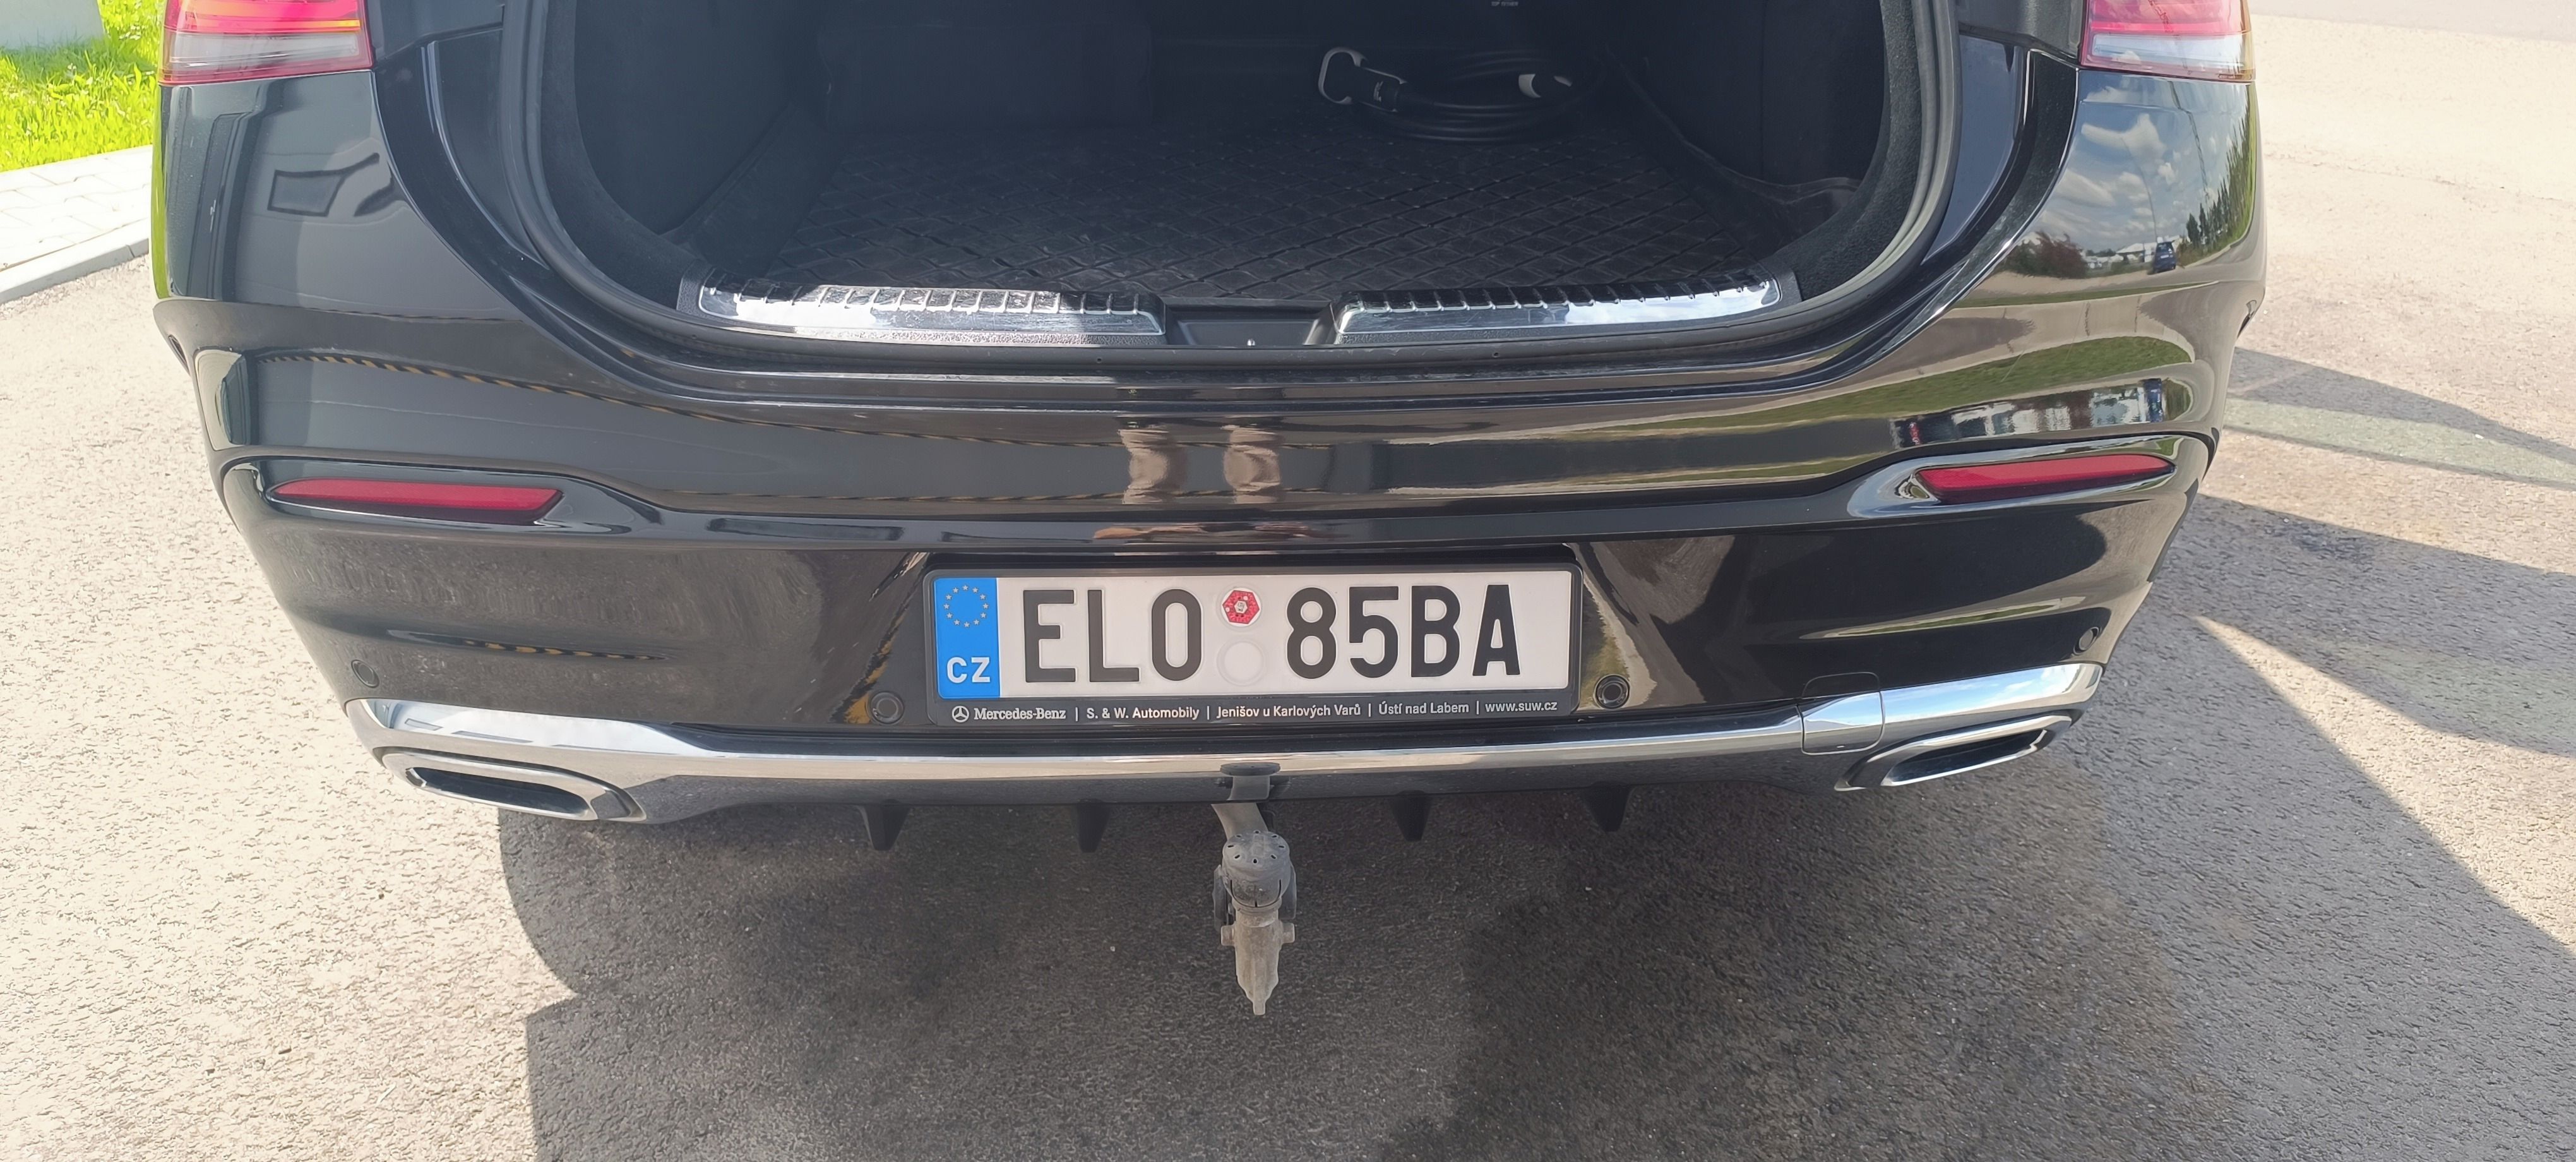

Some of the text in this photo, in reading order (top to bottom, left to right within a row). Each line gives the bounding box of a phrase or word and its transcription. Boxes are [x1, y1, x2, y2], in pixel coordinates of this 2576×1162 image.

[1286, 584, 1521, 680] 85BA
[946, 657, 991, 683] CZ
[974, 701, 1558, 720] Mercedes-Benz S. & W. Automobily Jenišov u Karlových Varů Ústí nad Labem www.suw.cz
